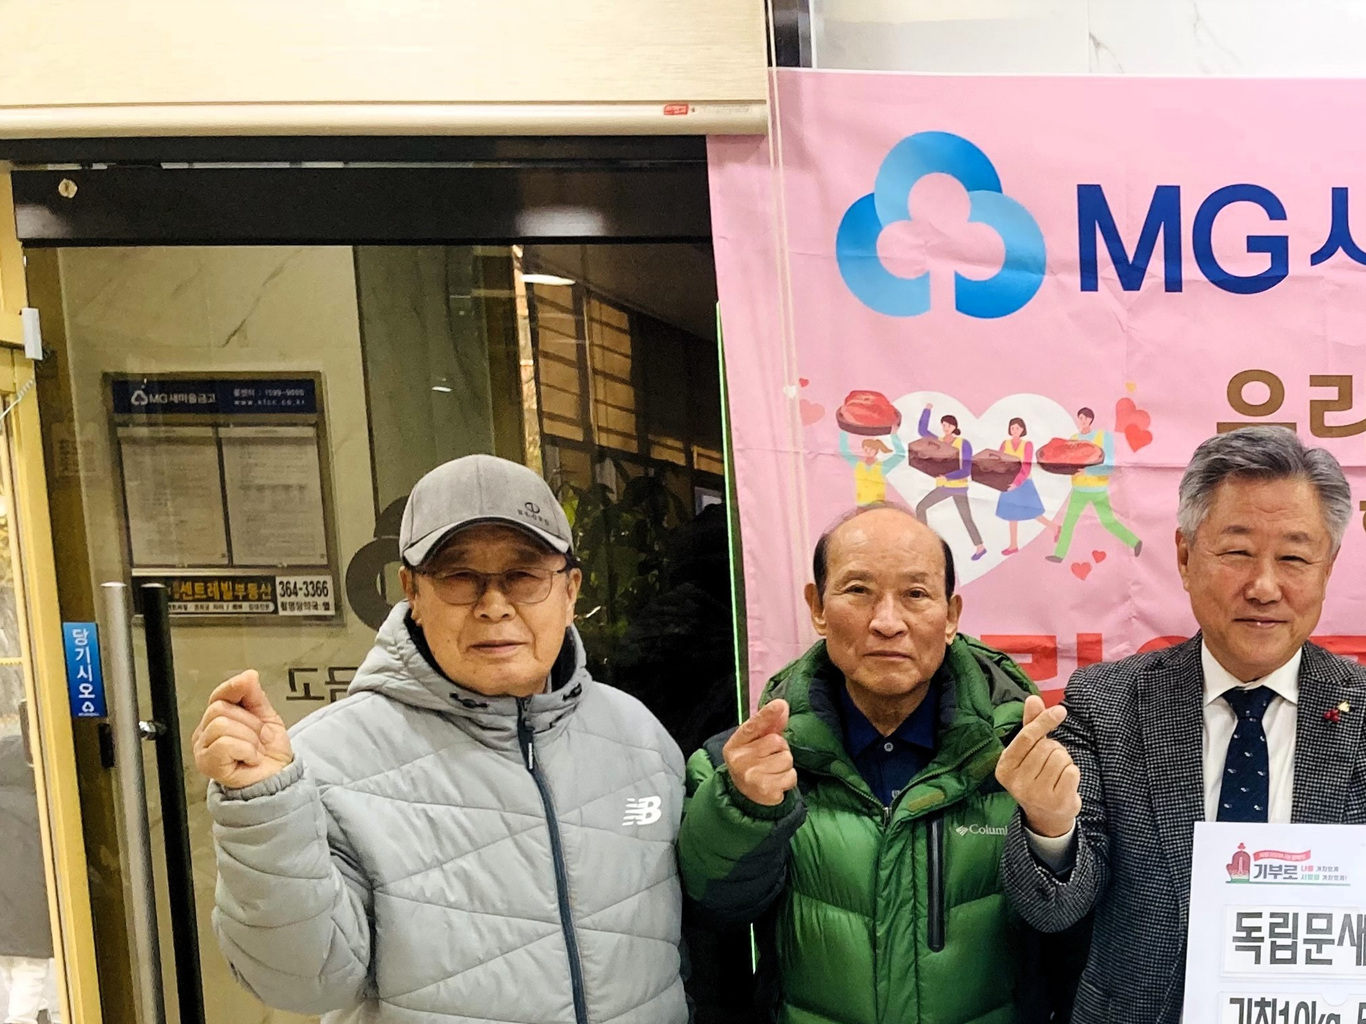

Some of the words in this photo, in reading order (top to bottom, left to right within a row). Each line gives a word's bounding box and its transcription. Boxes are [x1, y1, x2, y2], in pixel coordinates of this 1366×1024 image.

[278, 580, 329, 598] 364-3366
[72, 628, 96, 698] 당기시오
[969, 823, 1008, 836] Colum
[1253, 863, 1298, 880] 기부로
